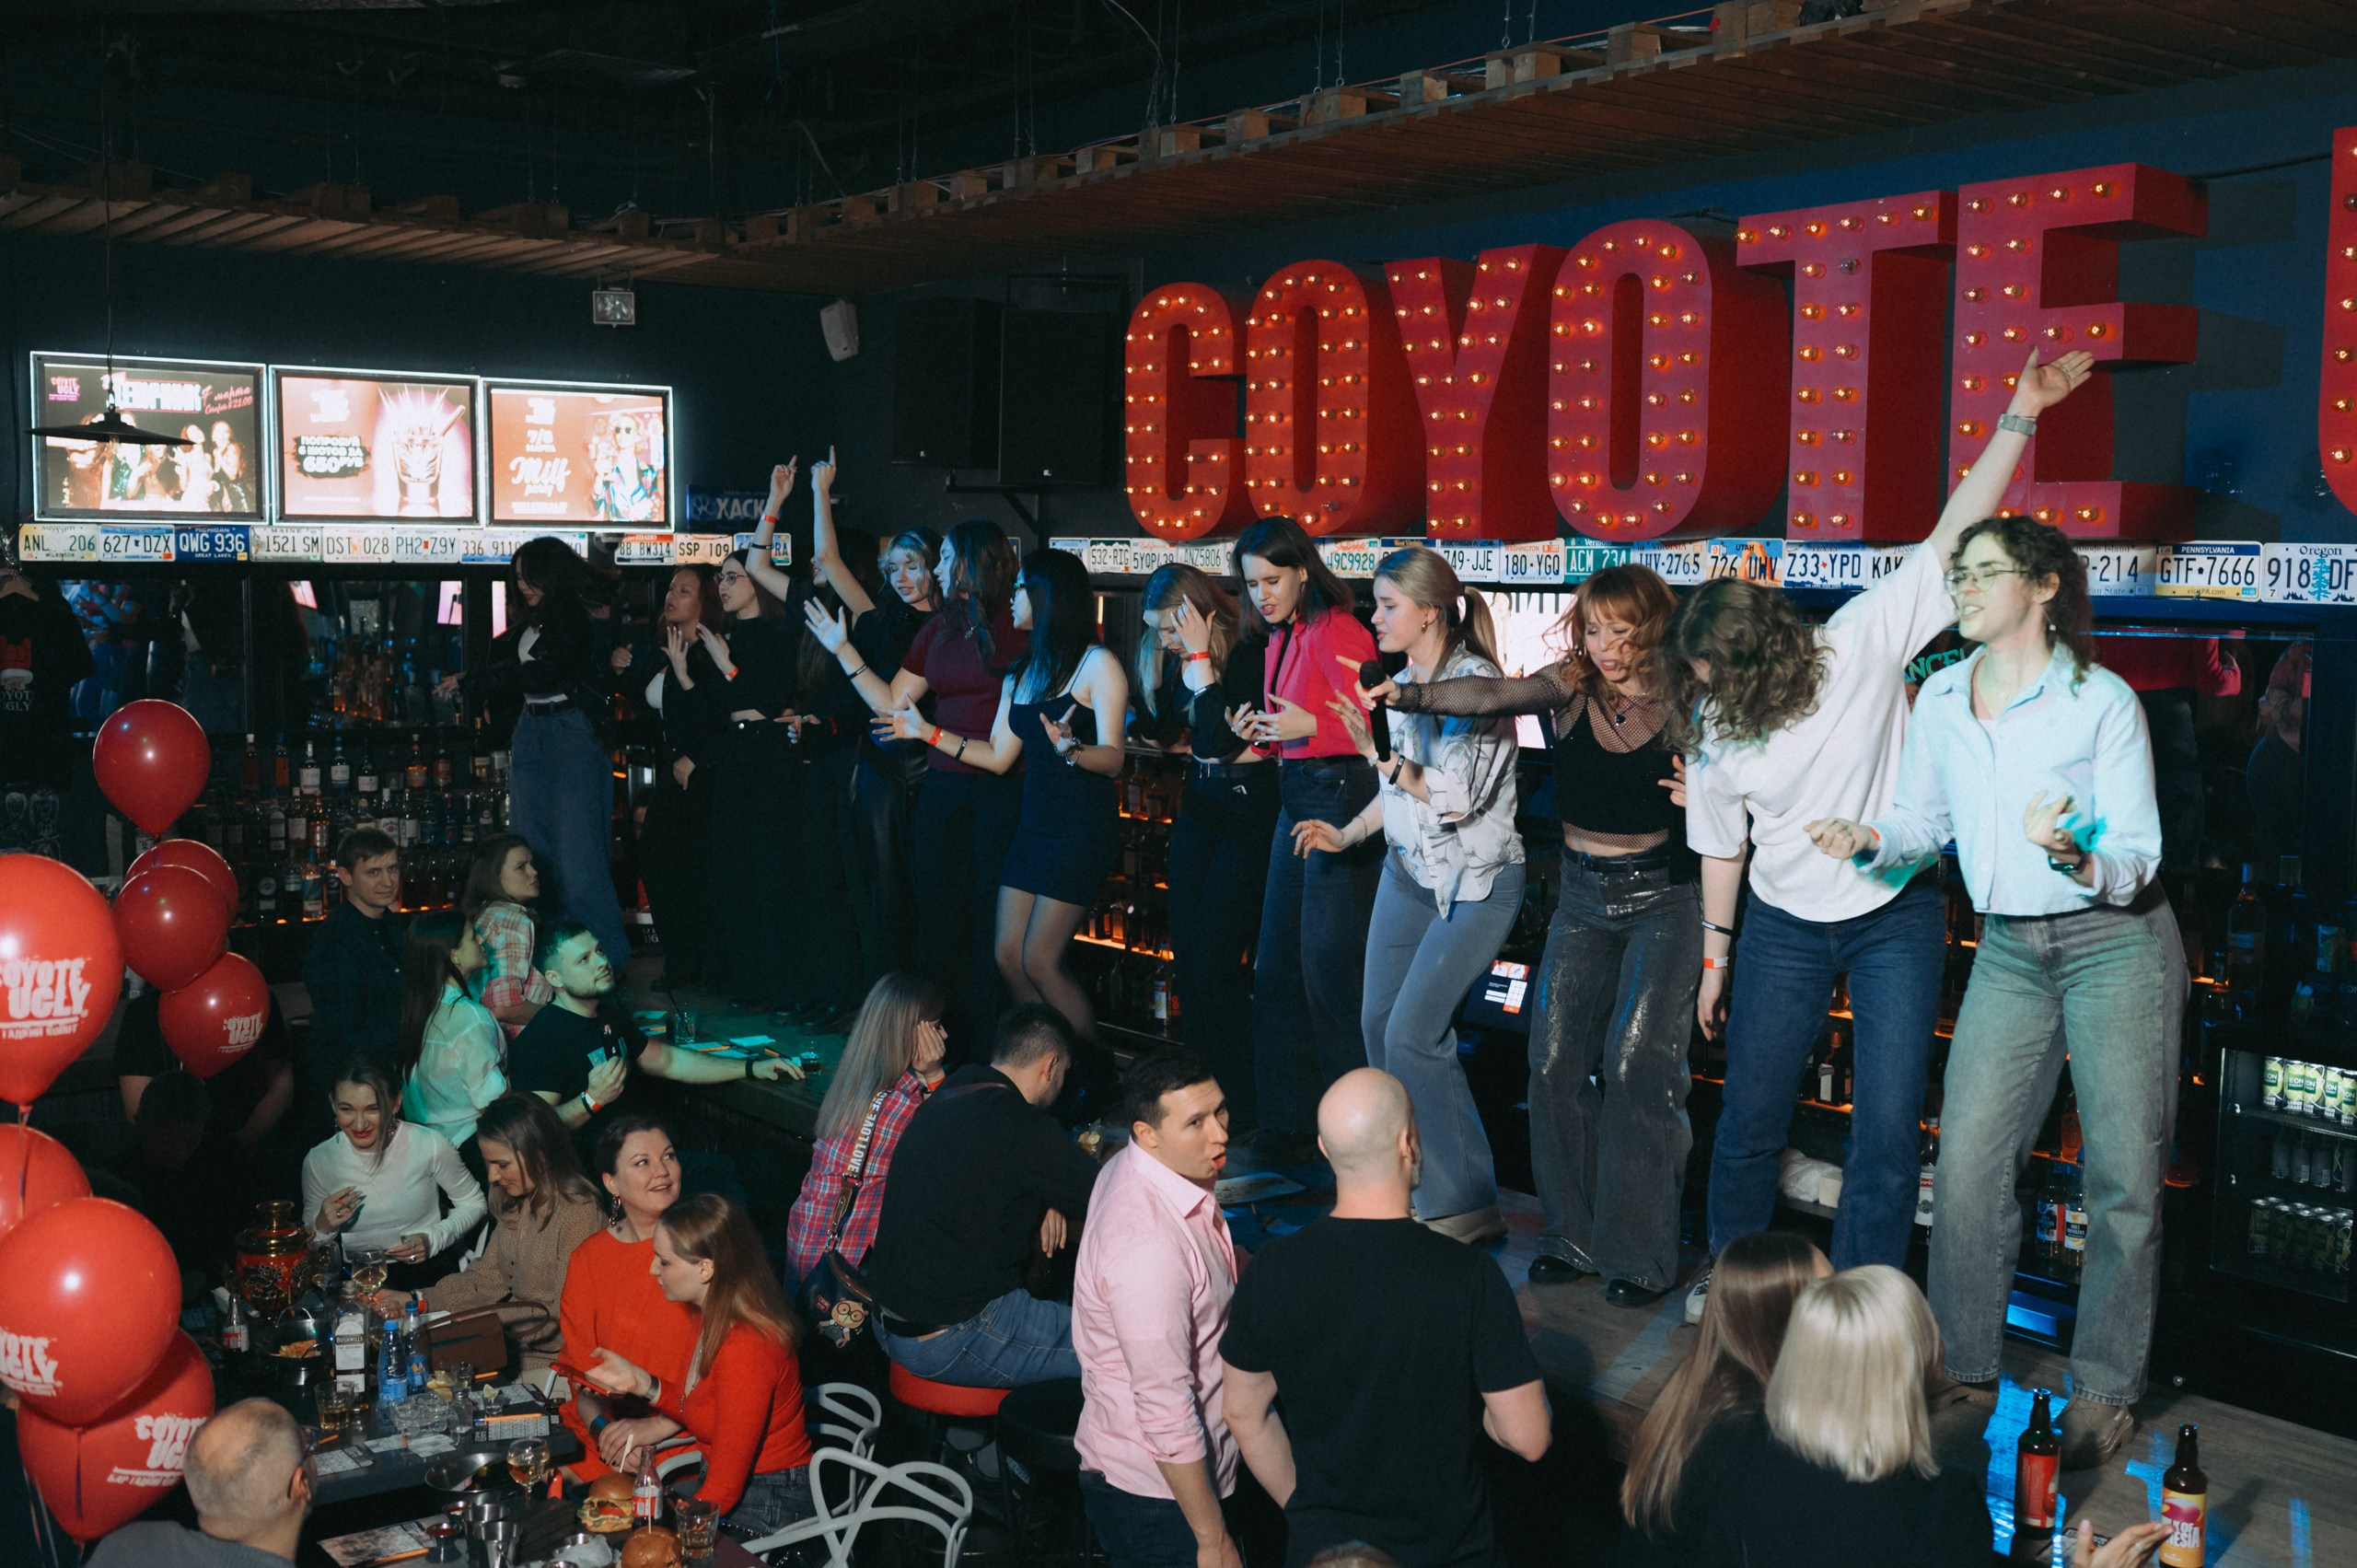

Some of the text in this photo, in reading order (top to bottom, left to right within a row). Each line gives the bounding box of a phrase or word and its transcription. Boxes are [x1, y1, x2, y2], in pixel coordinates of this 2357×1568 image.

[1125, 162, 2138, 541] COYOTE
[303, 456, 341, 473] 650
[24, 535, 96, 551] ANL 206
[103, 535, 171, 552] 627 DZX
[180, 532, 245, 552] QWG 936
[266, 536, 319, 552] 1521 SM
[327, 537, 389, 554] DST 028
[396, 537, 456, 554] PH2 Z9Y
[463, 540, 484, 556] 336
[679, 542, 700, 556] SSP
[710, 543, 729, 557] 109
[1653, 542, 1687, 551] VIRGINIA
[1713, 546, 1718, 554] 9
[2181, 546, 2235, 554] PENNSYLVANIA
[2299, 546, 2342, 558] Oregon
[1570, 550, 1594, 572] ACM
[1711, 556, 1737, 578] 726
[1787, 553, 1862, 577] Z33 YPD
[2160, 557, 2255, 586] GTF 7666
[2268, 557, 2311, 588] 918
[2105, 587, 2126, 595] State
[7, 982, 92, 1019] UGLY
[858, 1113, 877, 1143] LOVE
[847, 1144, 866, 1173] LOVE
